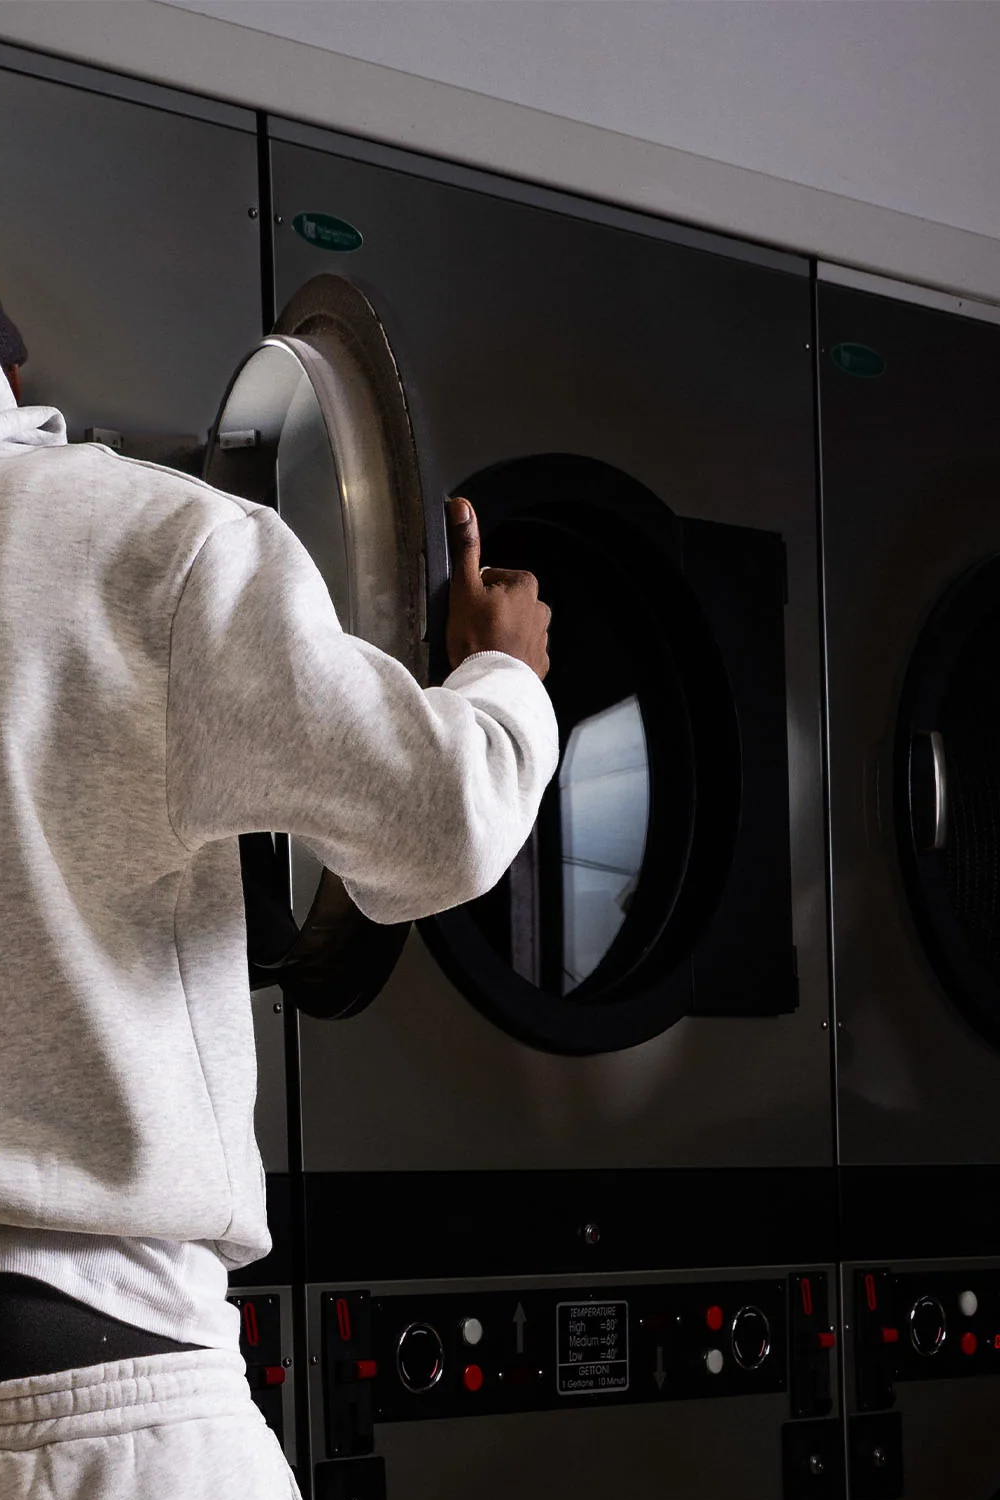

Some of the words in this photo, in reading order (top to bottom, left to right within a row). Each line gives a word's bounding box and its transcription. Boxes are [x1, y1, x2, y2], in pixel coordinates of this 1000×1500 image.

[570, 1306, 616, 1318] TEMPERATURE
[568, 1320, 586, 1335] High
[569, 1334, 599, 1347] Medium
[568, 1349, 584, 1362] Low
[578, 1365, 610, 1376] GETTONI
[598, 1377, 606, 1386] 10
